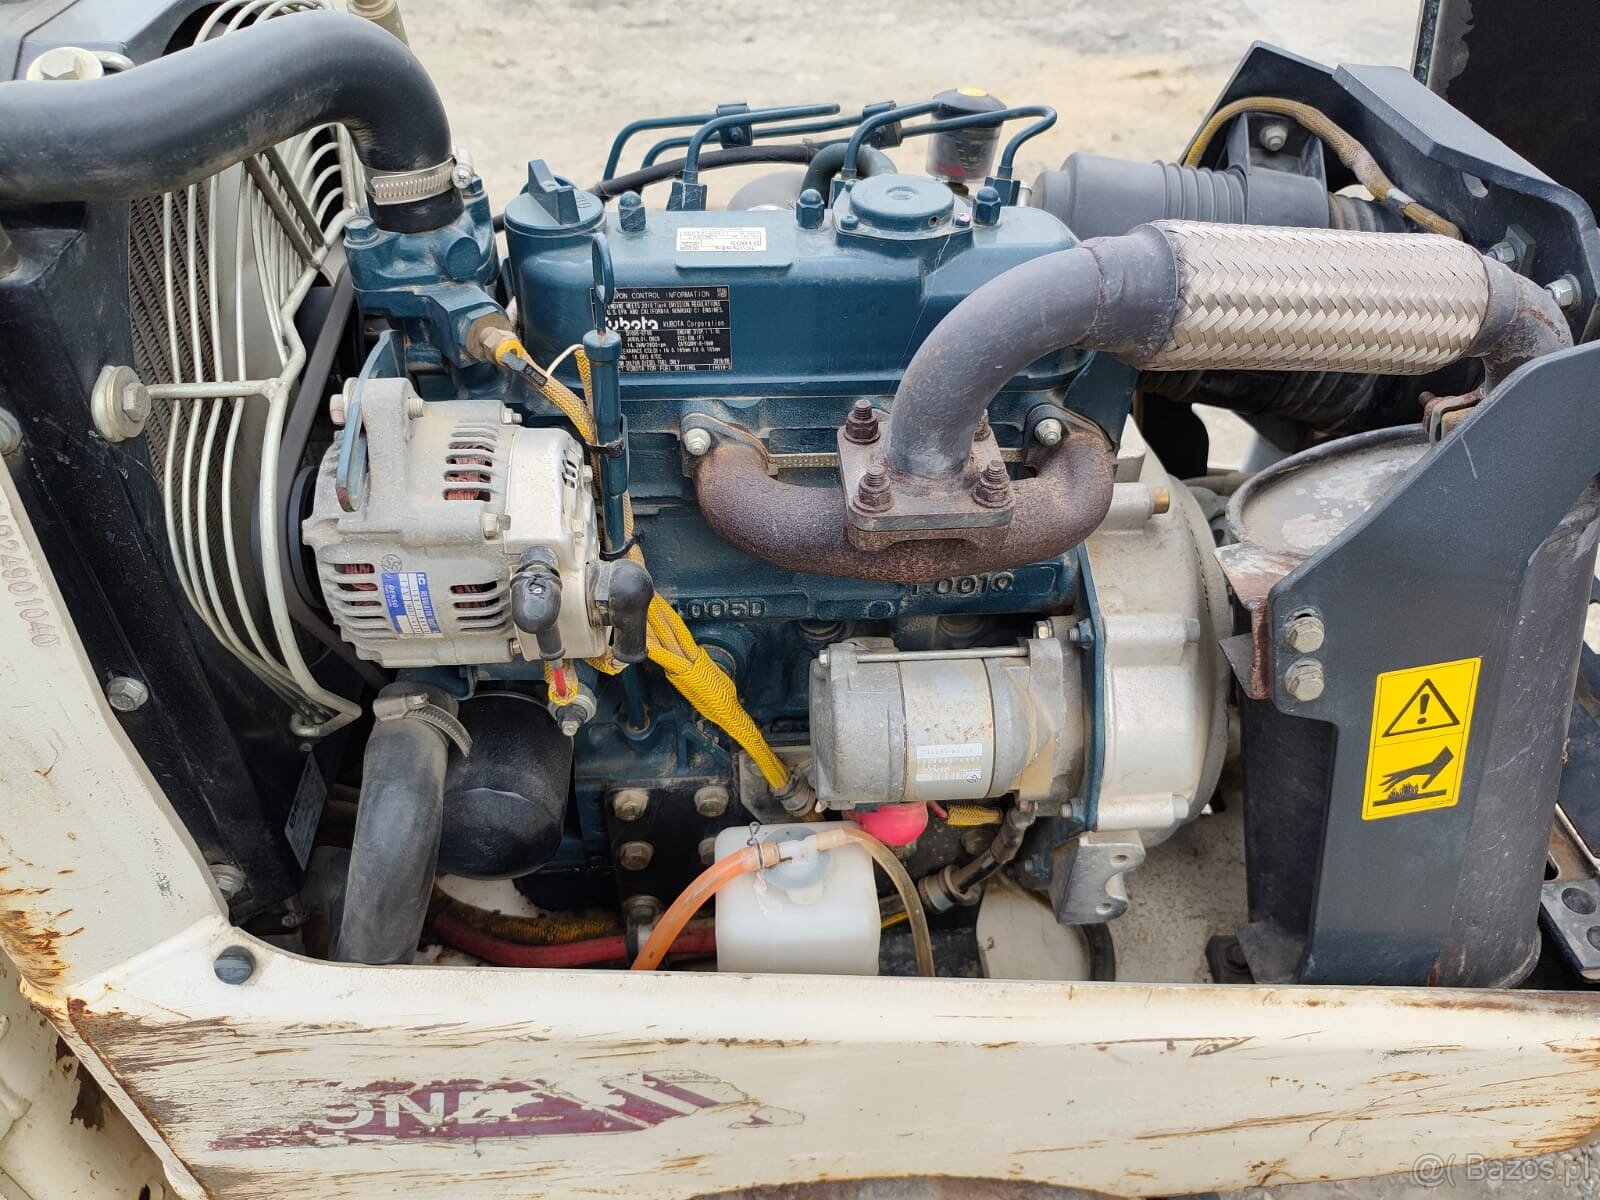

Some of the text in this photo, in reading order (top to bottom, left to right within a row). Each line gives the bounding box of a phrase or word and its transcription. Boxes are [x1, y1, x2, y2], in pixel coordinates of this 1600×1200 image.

[665, 291, 710, 299] INFORMATION
[605, 316, 725, 330] ubota KUBOTA Corporation
